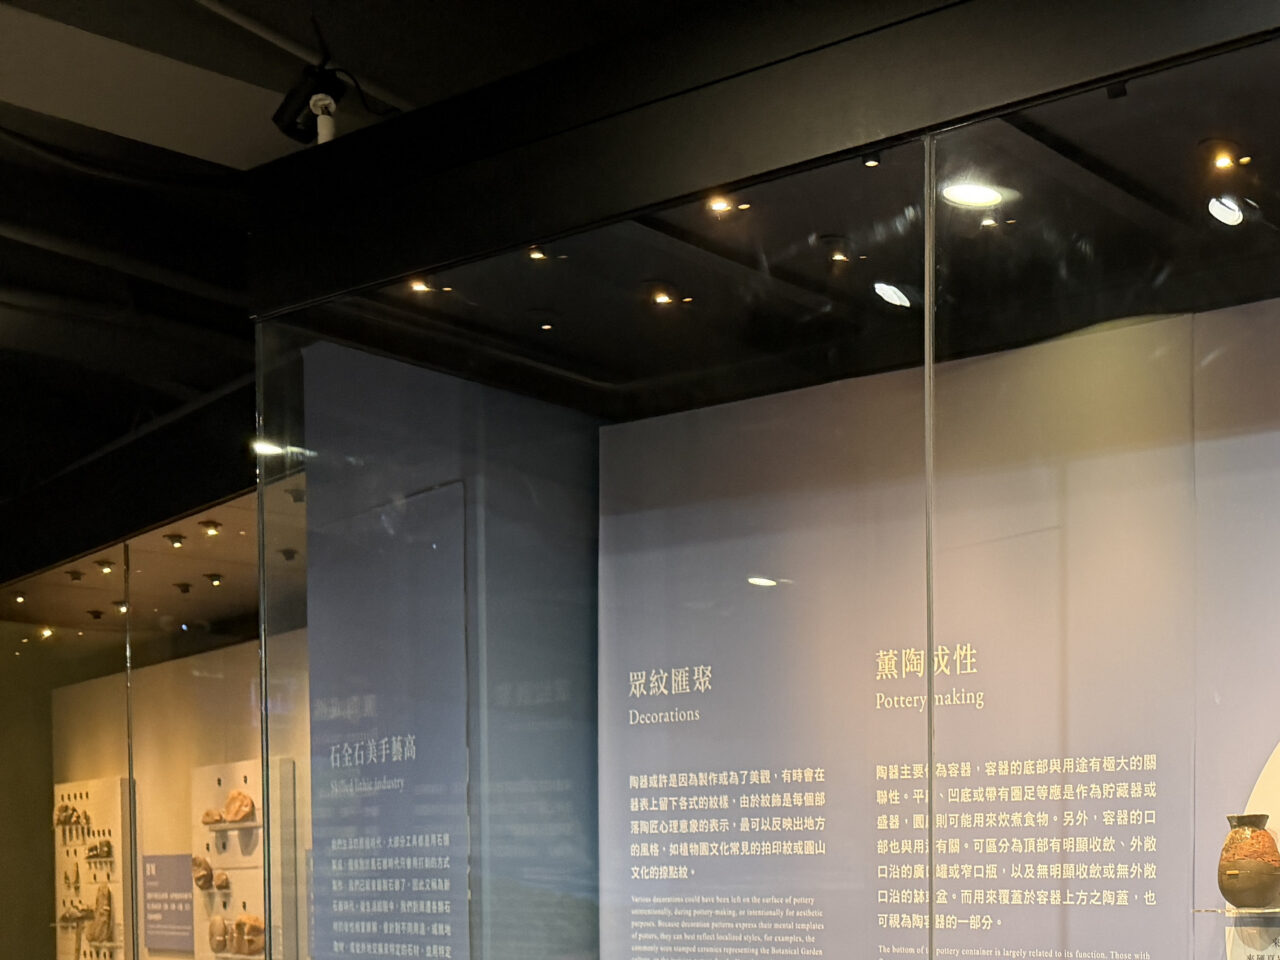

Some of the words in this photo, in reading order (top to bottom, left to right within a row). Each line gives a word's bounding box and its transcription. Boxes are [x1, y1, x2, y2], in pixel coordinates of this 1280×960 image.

[876, 693, 926, 712] Pottery
[629, 708, 700, 725] Decorations
[877, 781, 1157, 804] 聯性。平、凹底或帶有圈足等應是作為貯藏器或
[877, 810, 1156, 830] 盛器，圓則可能用來炊煮食物。另外，容器的口
[935, 947, 959, 957] pottery
[961, 947, 992, 956] container
[994, 948, 1000, 956] is
[1002, 948, 1026, 958] largely
[1028, 948, 1052, 957] related
[1054, 949, 1061, 957] to
[1064, 949, 1073, 957] its
[1110, 950, 1131, 958] Those
[1134, 951, 1150, 959] with
